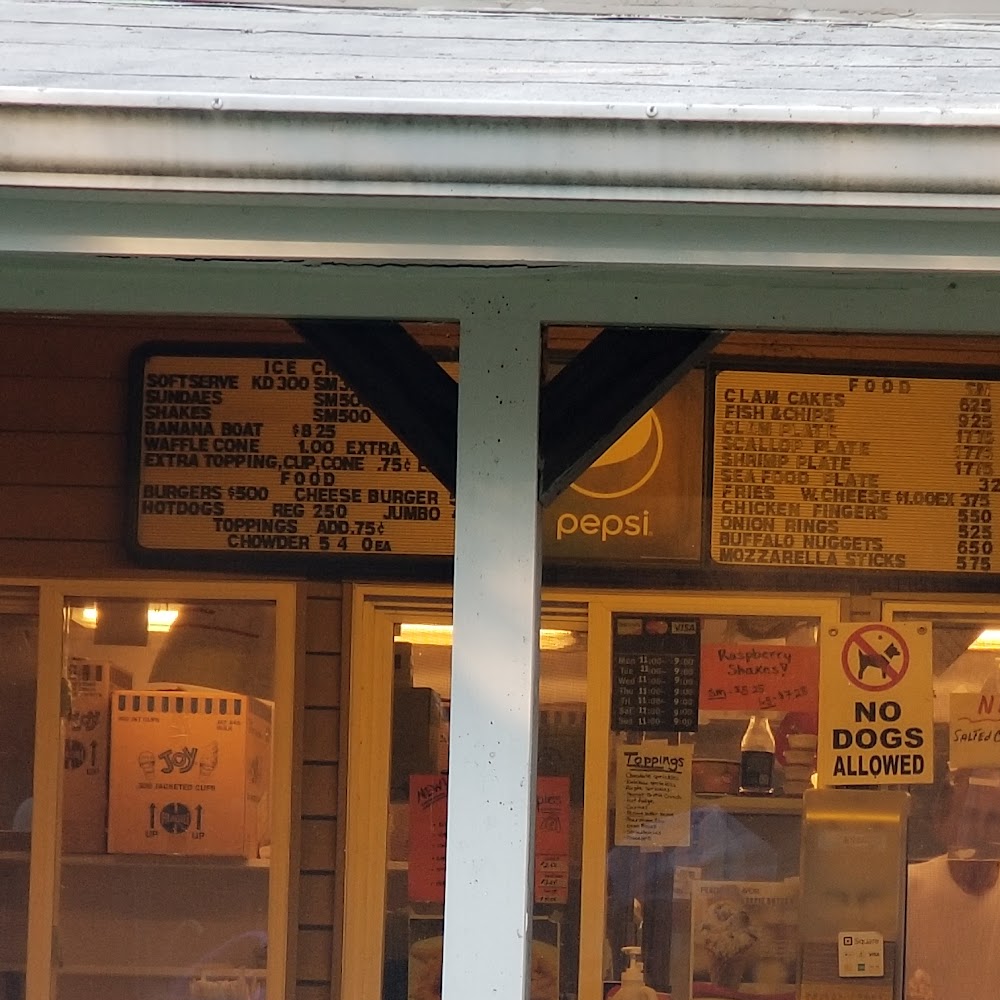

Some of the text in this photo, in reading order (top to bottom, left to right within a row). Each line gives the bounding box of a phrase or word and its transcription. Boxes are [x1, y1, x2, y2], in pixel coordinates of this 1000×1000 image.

[264, 360, 298, 374] ICE
[252, 376, 274, 390] KD
[277, 377, 310, 391] 300
[314, 377, 338, 391] SM
[848, 378, 911, 394] FOOD
[146, 390, 223, 404] SUNDAES
[724, 388, 779, 404] CLAM
[787, 391, 846, 407] CAKES
[145, 405, 212, 420] SHAKES
[725, 405, 765, 419] FISH
[959, 414, 991, 428] 925
[145, 421, 215, 436] BANANA
[221, 422, 264, 437] BOAT
[722, 421, 772, 436] CLAM
[779, 423, 837, 438] PLATE
[145, 437, 209, 452] WAFFLE
[213, 438, 260, 453] CONE
[346, 441, 402, 455] EXTRA
[722, 436, 802, 452] SCALLOP
[813, 440, 871, 455] PLATE
[145, 453, 199, 467] EXTRA
[722, 452, 788, 467] SHRIMP
[796, 456, 852, 470] PLATE
[281, 471, 335, 486] FOOD
[824, 473, 880, 488] PLATE
[143, 484, 222, 499] BURGERS
[295, 487, 362, 503] CHEESE
[368, 489, 439, 505] BURGER
[722, 485, 776, 499] FRIES
[959, 493, 990, 507] 375
[141, 500, 225, 515] HOTDOGS
[272, 503, 305, 518] REG
[313, 504, 348, 518] 250
[383, 506, 441, 520] JUMBO
[721, 499, 801, 516] CHICKEN
[812, 504, 889, 520] FINGERS
[957, 508, 992, 523] 550
[213, 517, 298, 533] TOPPINGS
[556, 510, 650, 542] pepsi
[720, 517, 775, 531] ONION
[784, 520, 840, 533] RINGS
[957, 524, 991, 540] 525
[228, 534, 310, 549] CHOWDER
[719, 532, 794, 547] BUFFALO
[802, 535, 883, 551] NUGGETS
[957, 540, 992, 555] 650
[719, 548, 838, 565] MOZZARELLA
[845, 553, 908, 568] STICKS
[956, 556, 991, 571] 575
[674, 623, 696, 632] VISA
[717, 648, 792, 664] Raspberry
[855, 701, 902, 722] NO
[832, 727, 925, 750] DOGS
[623, 751, 685, 772] Toppings
[833, 754, 925, 778] ALLOWED
[145, 831, 159, 839] UP
[192, 832, 205, 840] UP
[854, 937, 880, 945] Square
